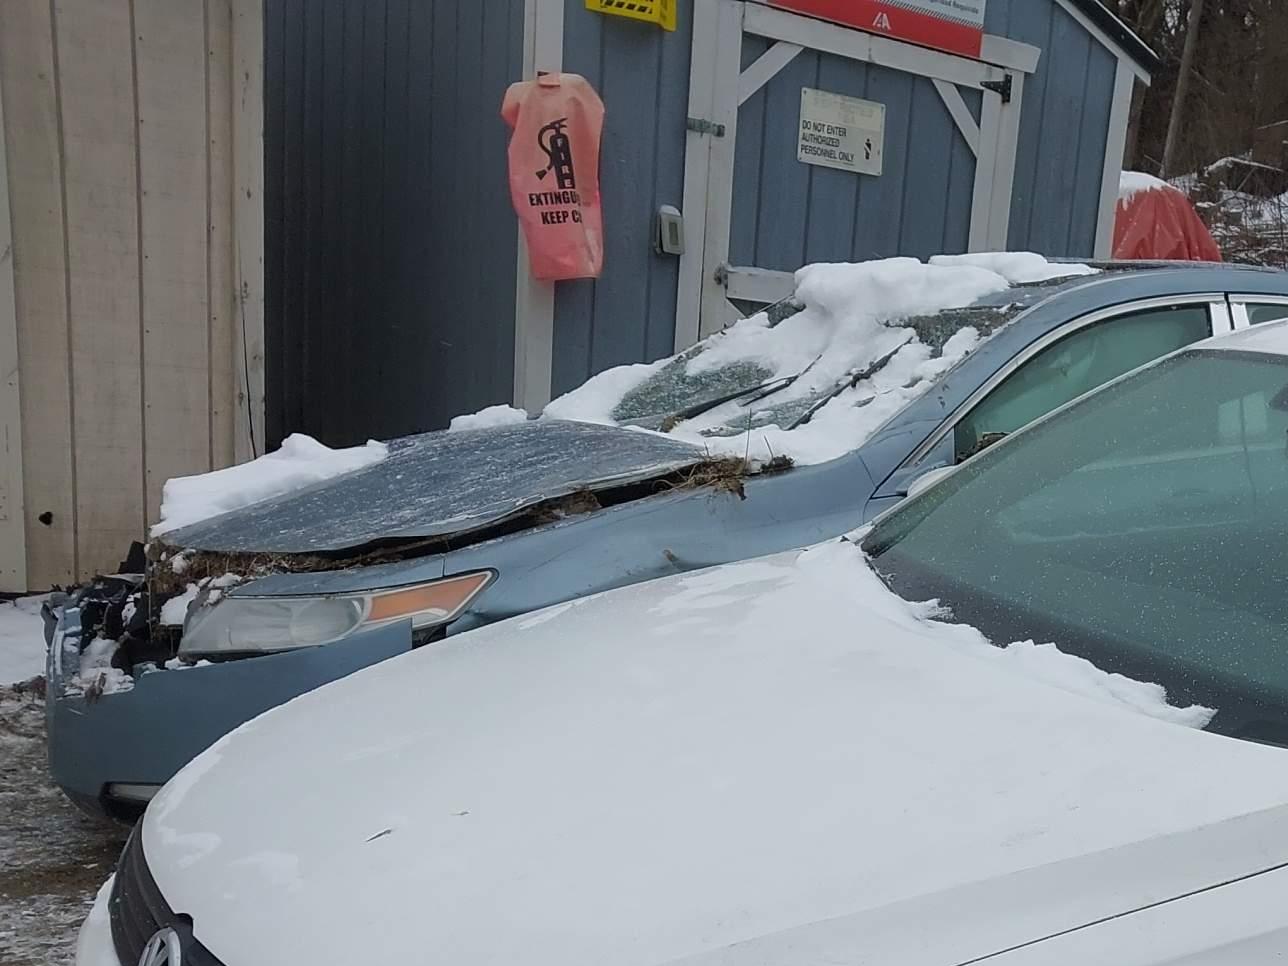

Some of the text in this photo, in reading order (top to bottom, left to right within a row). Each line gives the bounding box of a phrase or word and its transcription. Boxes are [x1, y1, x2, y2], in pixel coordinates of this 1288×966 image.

[802, 120, 847, 137] DO NOT ENTER
[801, 132, 840, 147] AUTHORIZED
[800, 144, 854, 162] PERSONNEL ONLY
[556, 138, 573, 188] FIRE
[528, 190, 581, 207] EXTINGU
[541, 210, 569, 225] KEEP
